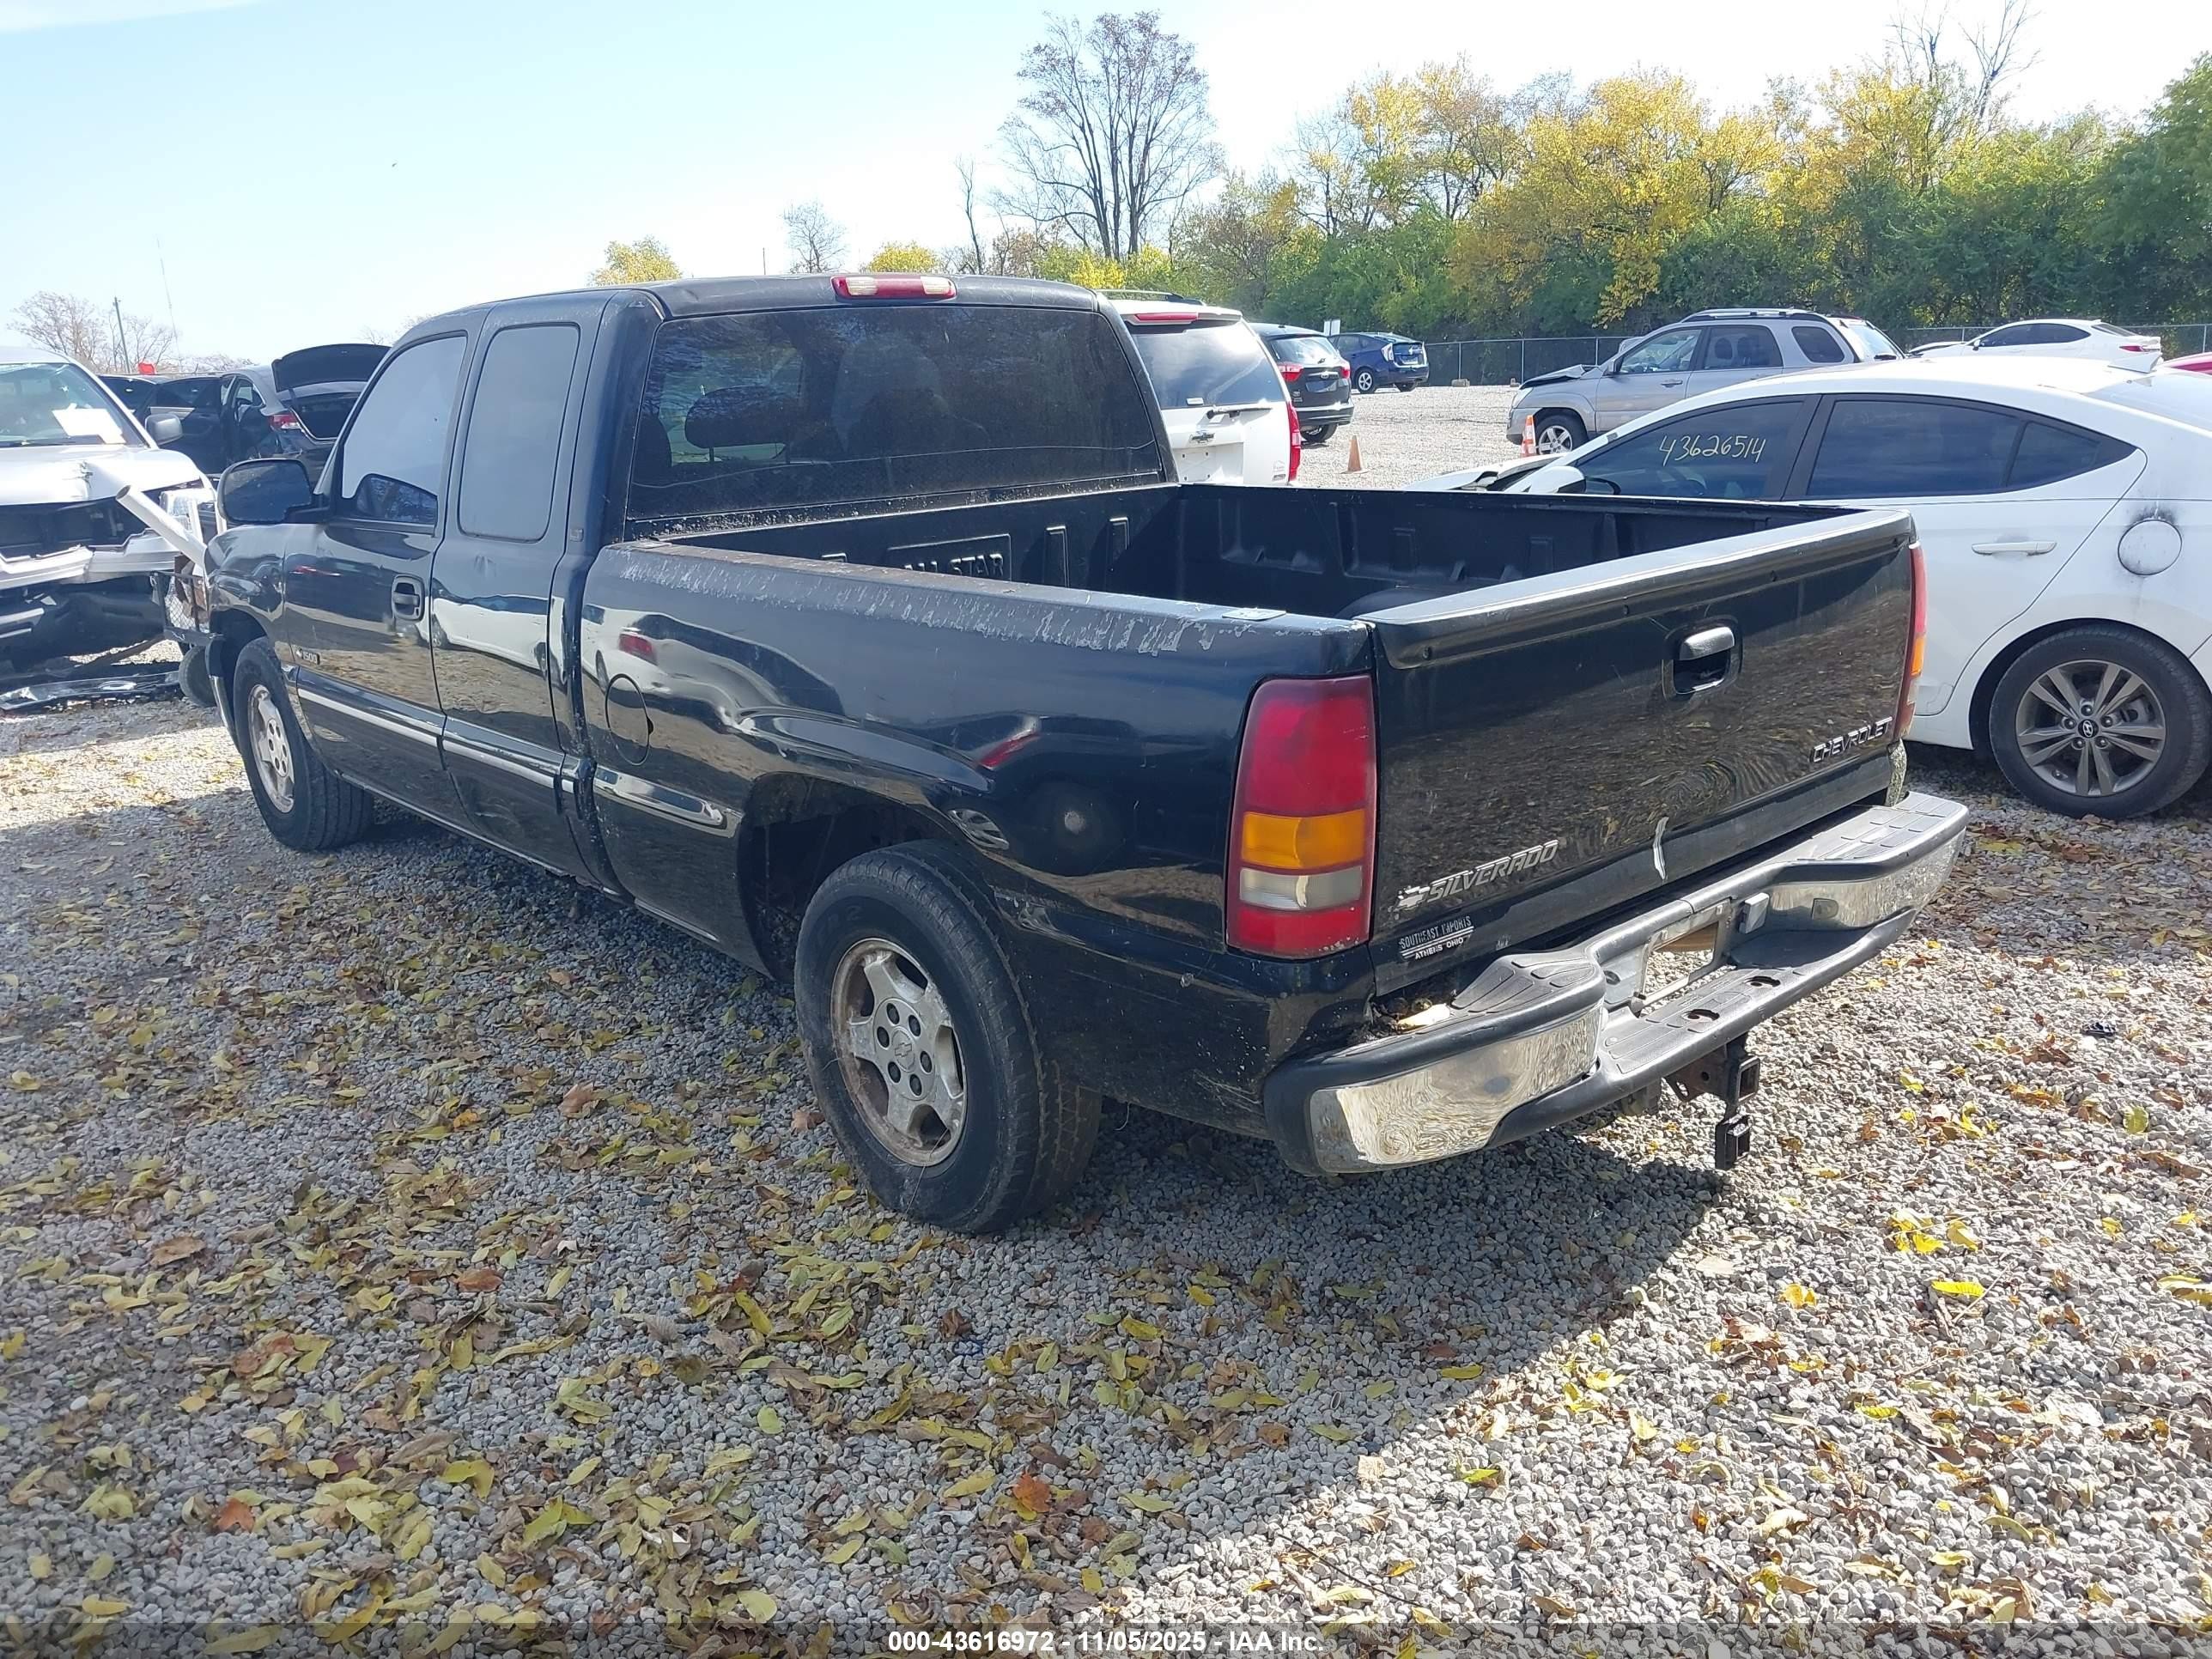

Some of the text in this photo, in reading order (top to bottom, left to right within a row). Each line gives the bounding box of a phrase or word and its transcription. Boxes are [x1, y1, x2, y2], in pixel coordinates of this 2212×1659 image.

[1659, 434, 1765, 466] 43626514
[1810, 716, 1893, 763] CHEVROLET
[1426, 839, 1559, 902] SILVERADO
[1401, 926, 1440, 949] SOUTHEAST
[1414, 937, 1464, 960] ATHENS OHIO
